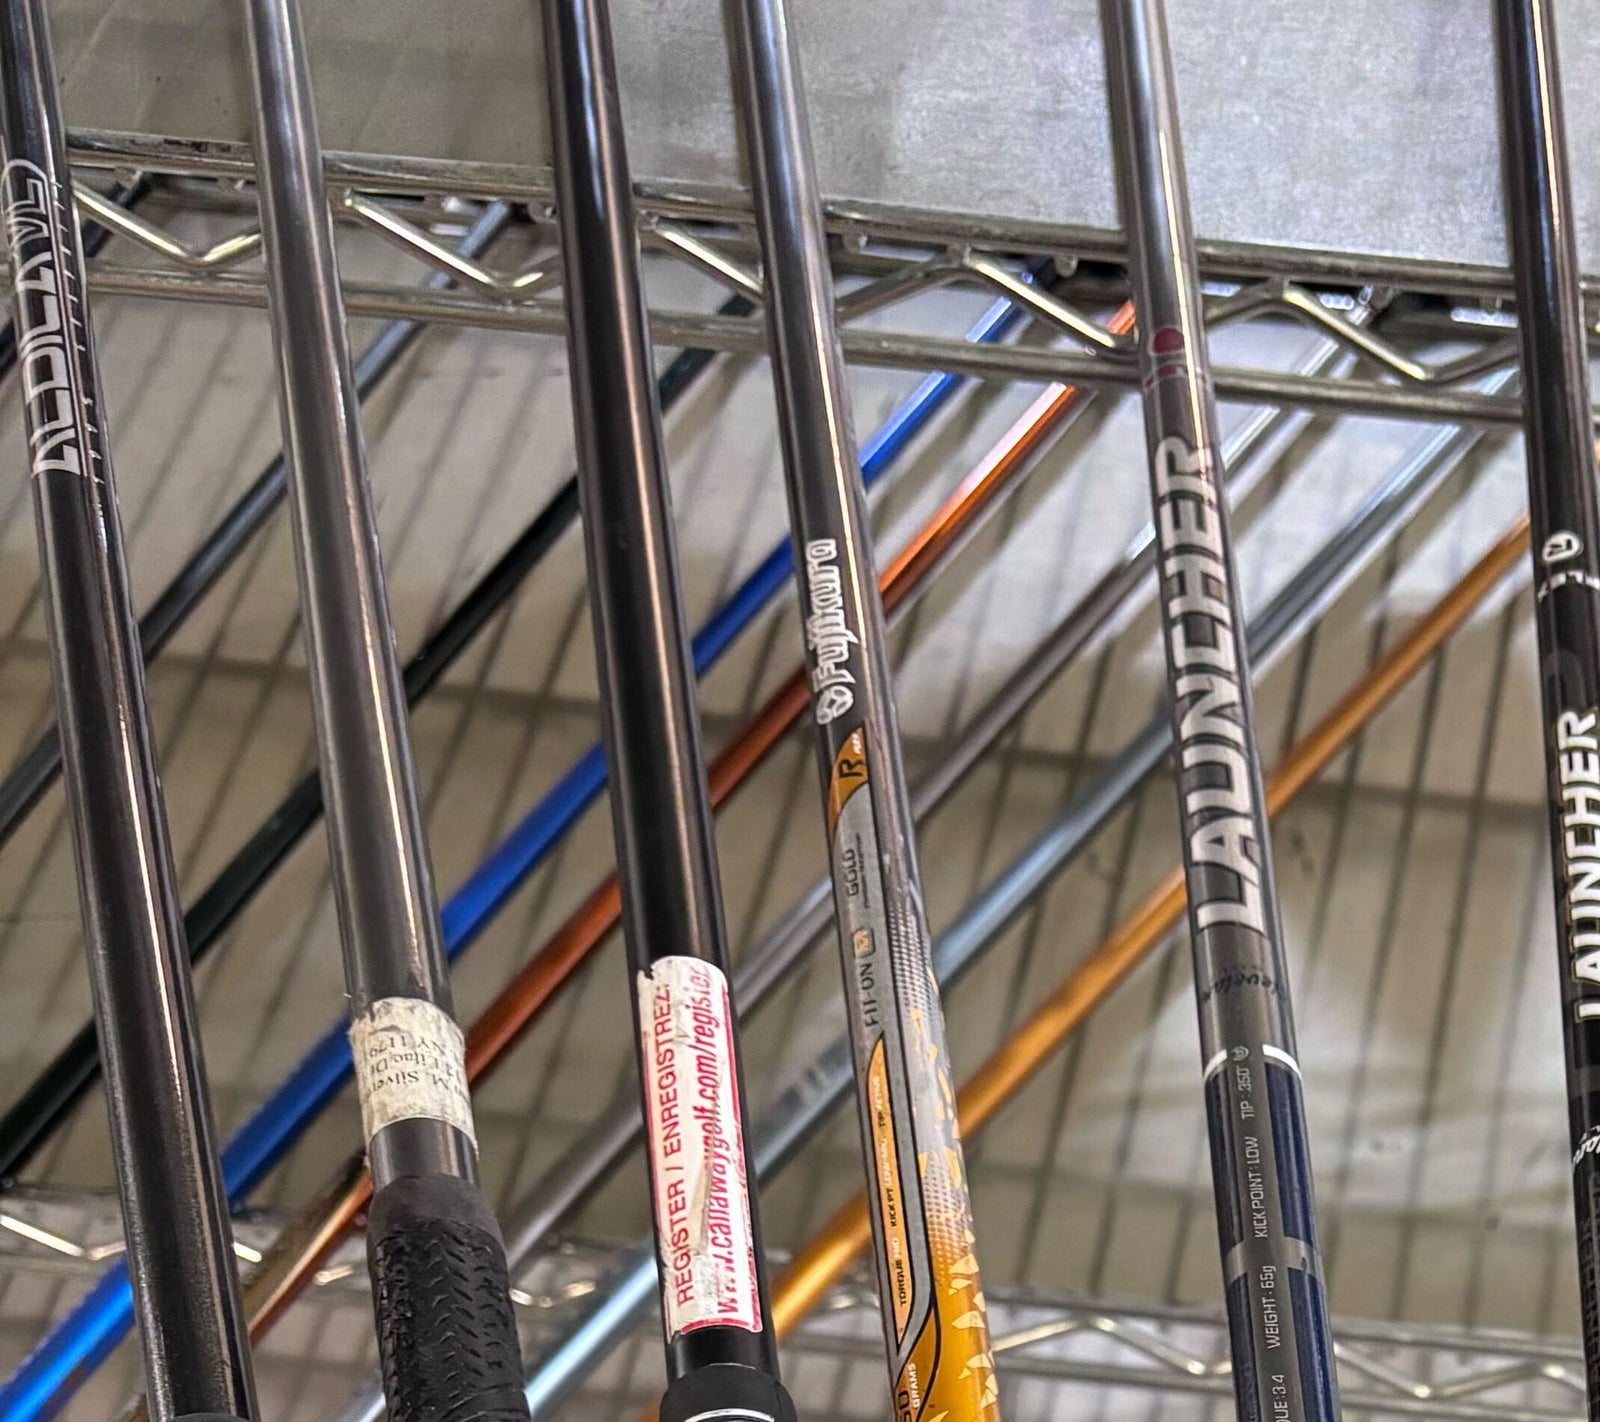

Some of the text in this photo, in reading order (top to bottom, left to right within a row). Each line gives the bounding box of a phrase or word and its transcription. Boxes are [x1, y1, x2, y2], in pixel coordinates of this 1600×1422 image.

[17, 250, 81, 476] ALDILA
[807, 539, 857, 693] Fujikura
[1155, 434, 1266, 936] LAUNCHER
[843, 848, 859, 897] GOLD
[1245, 1137, 1260, 1165] LOW
[667, 1180, 694, 1308] REGISTER
[1253, 1212, 1268, 1239] KICK
